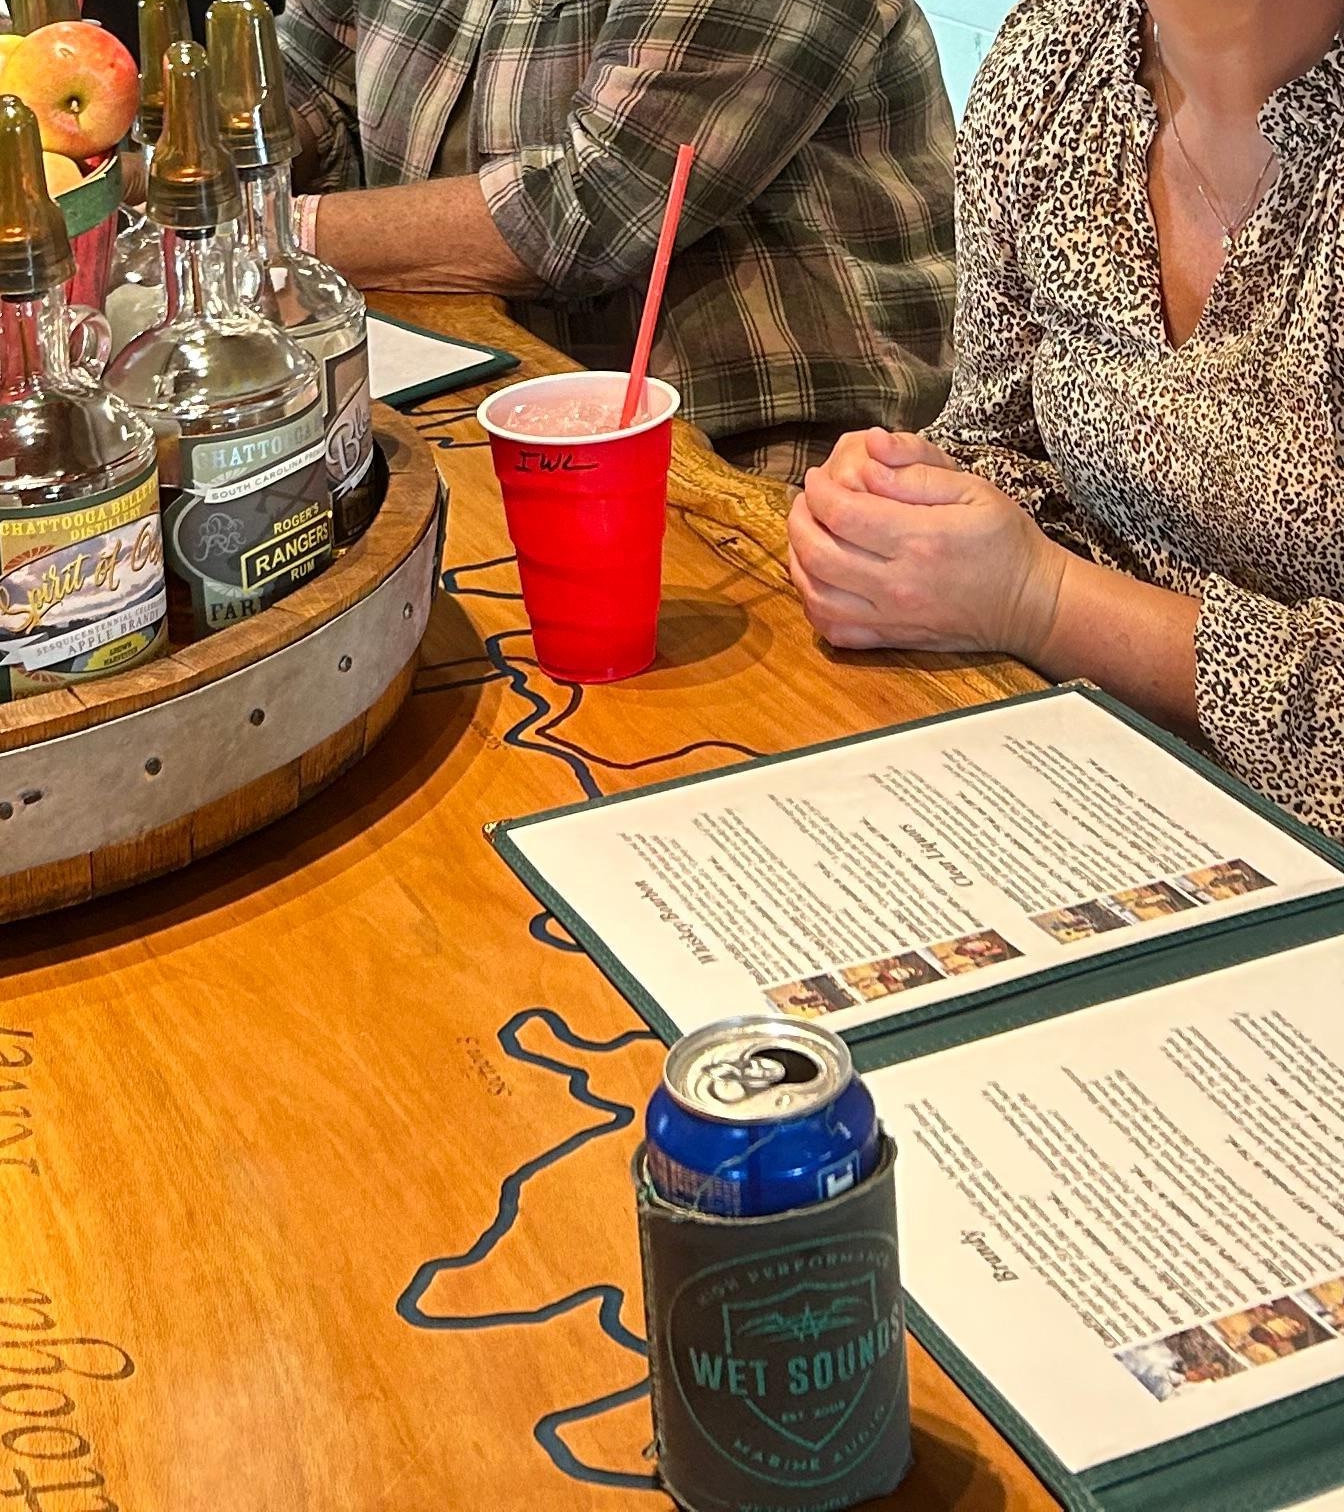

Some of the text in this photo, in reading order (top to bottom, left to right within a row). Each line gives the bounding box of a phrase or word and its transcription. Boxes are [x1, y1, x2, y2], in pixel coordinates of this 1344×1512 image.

[212, 482, 251, 500] SOUTH
[255, 459, 304, 486] CAROLINA
[70, 505, 143, 541] DISTILLERY
[273, 502, 319, 535] ROGER'S
[94, 539, 122, 592] of
[256, 523, 329, 576] RANGERS
[290, 559, 315, 583] RUM
[37, 614, 133, 656] SESQUICENTENNIAL
[67, 630, 112, 656] APPLE
[899, 822, 974, 888] Clear Liquors
[961, 1230, 1018, 1284] Brandy
[689, 1303, 900, 1397] WET SOUNDS
[733, 1403, 886, 1472] MARINE AUDIO
